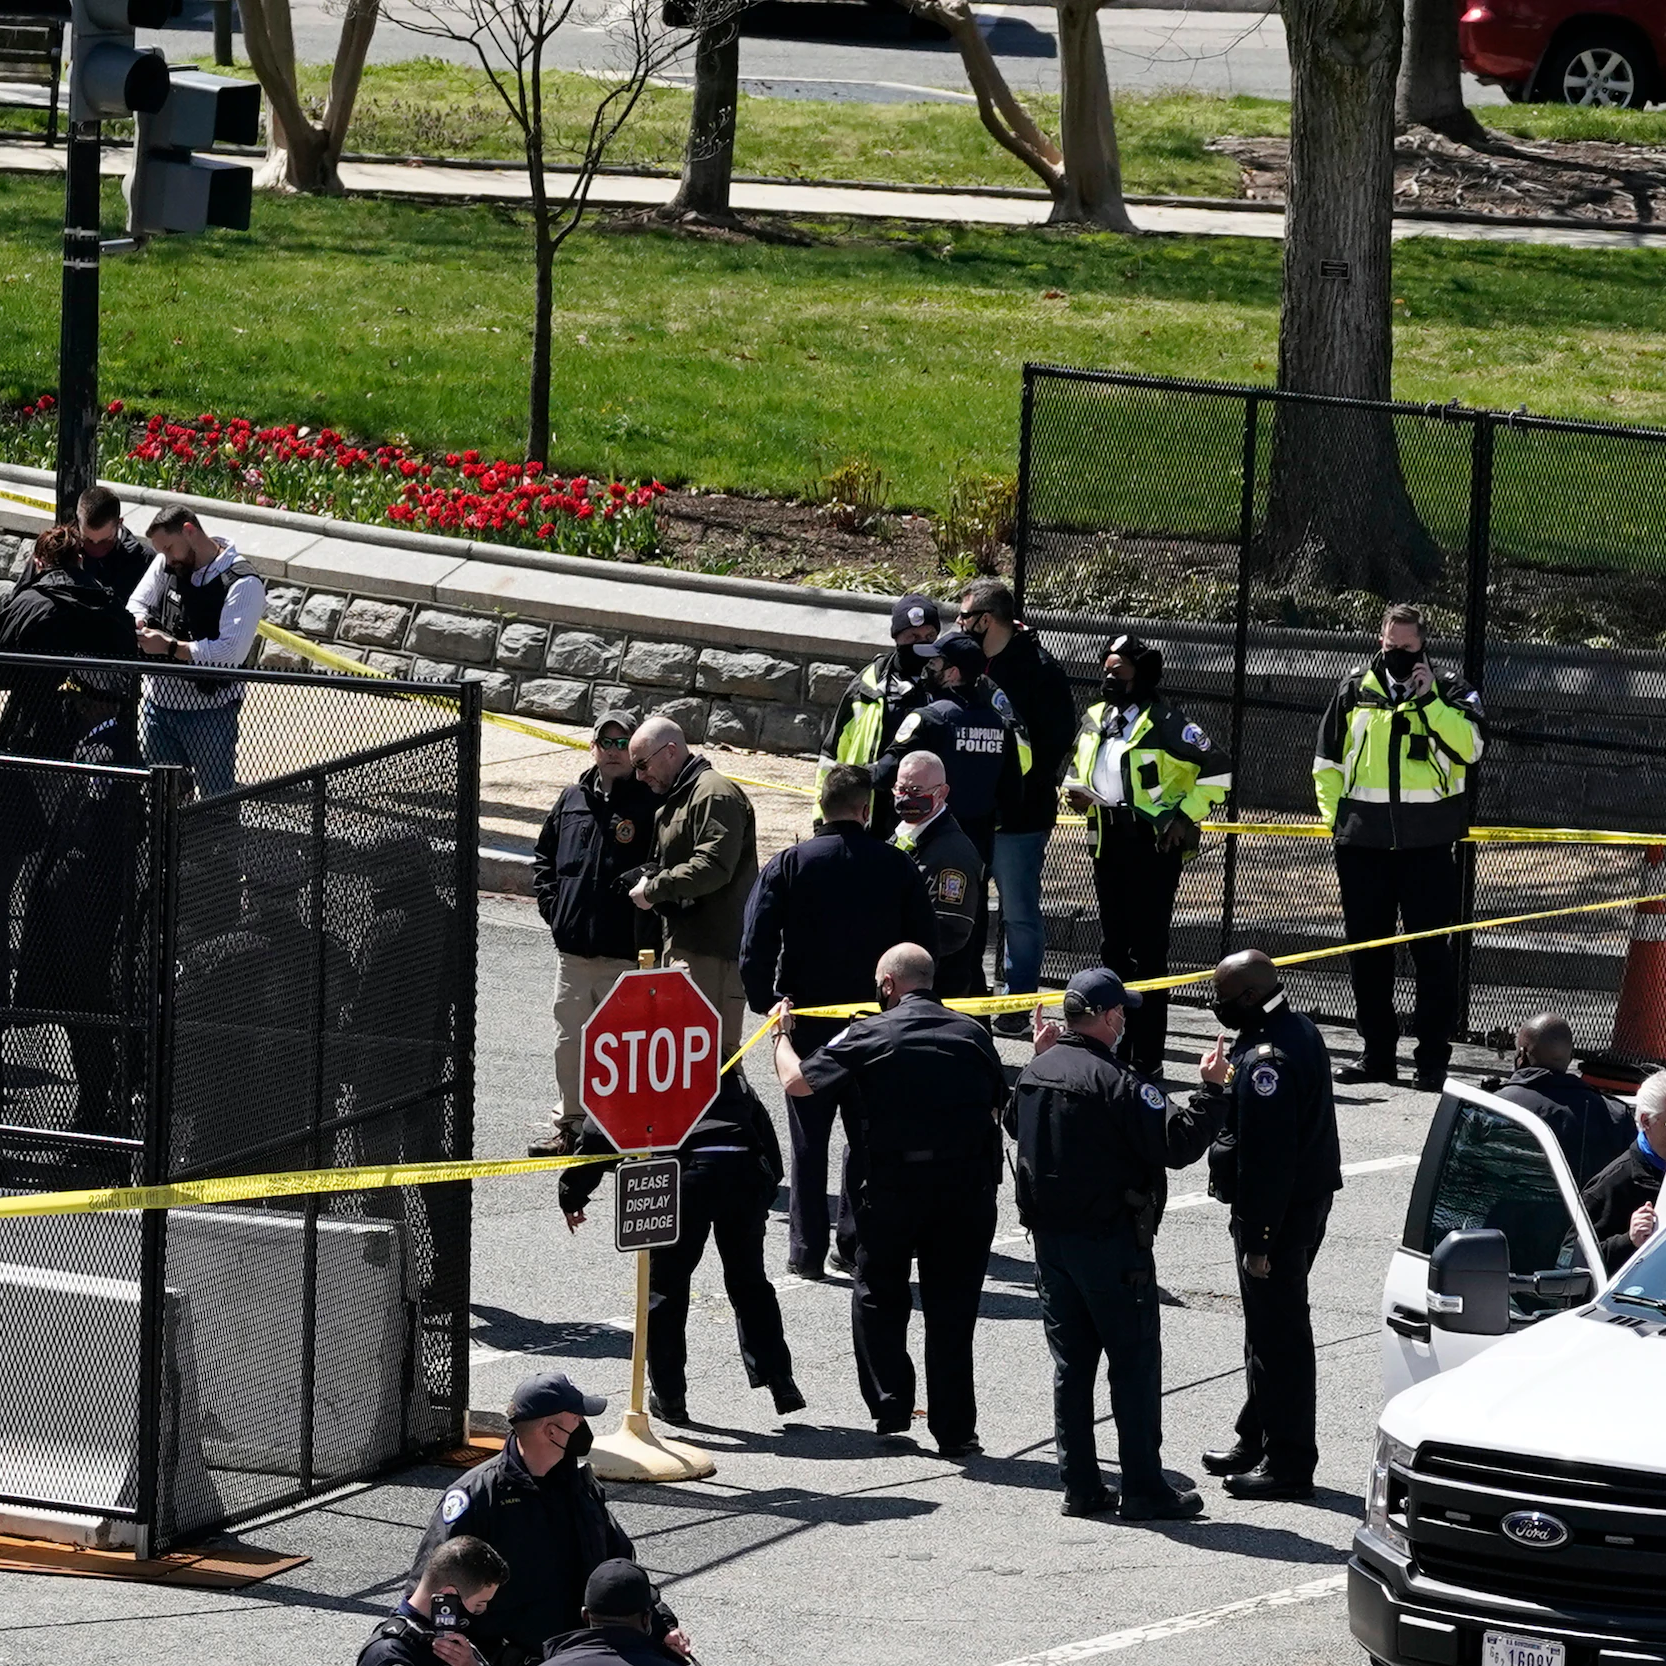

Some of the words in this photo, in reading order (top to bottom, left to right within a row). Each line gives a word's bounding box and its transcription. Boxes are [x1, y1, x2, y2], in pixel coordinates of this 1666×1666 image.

[956, 739, 1003, 754] POLICE
[591, 1026, 711, 1097] STOP
[627, 1173, 670, 1193] PLEASE
[626, 1194, 671, 1214] DISPLAY
[623, 1219, 634, 1234] ID
[636, 1214, 674, 1232] BADGE
[1516, 1520, 1551, 1541] Ford
